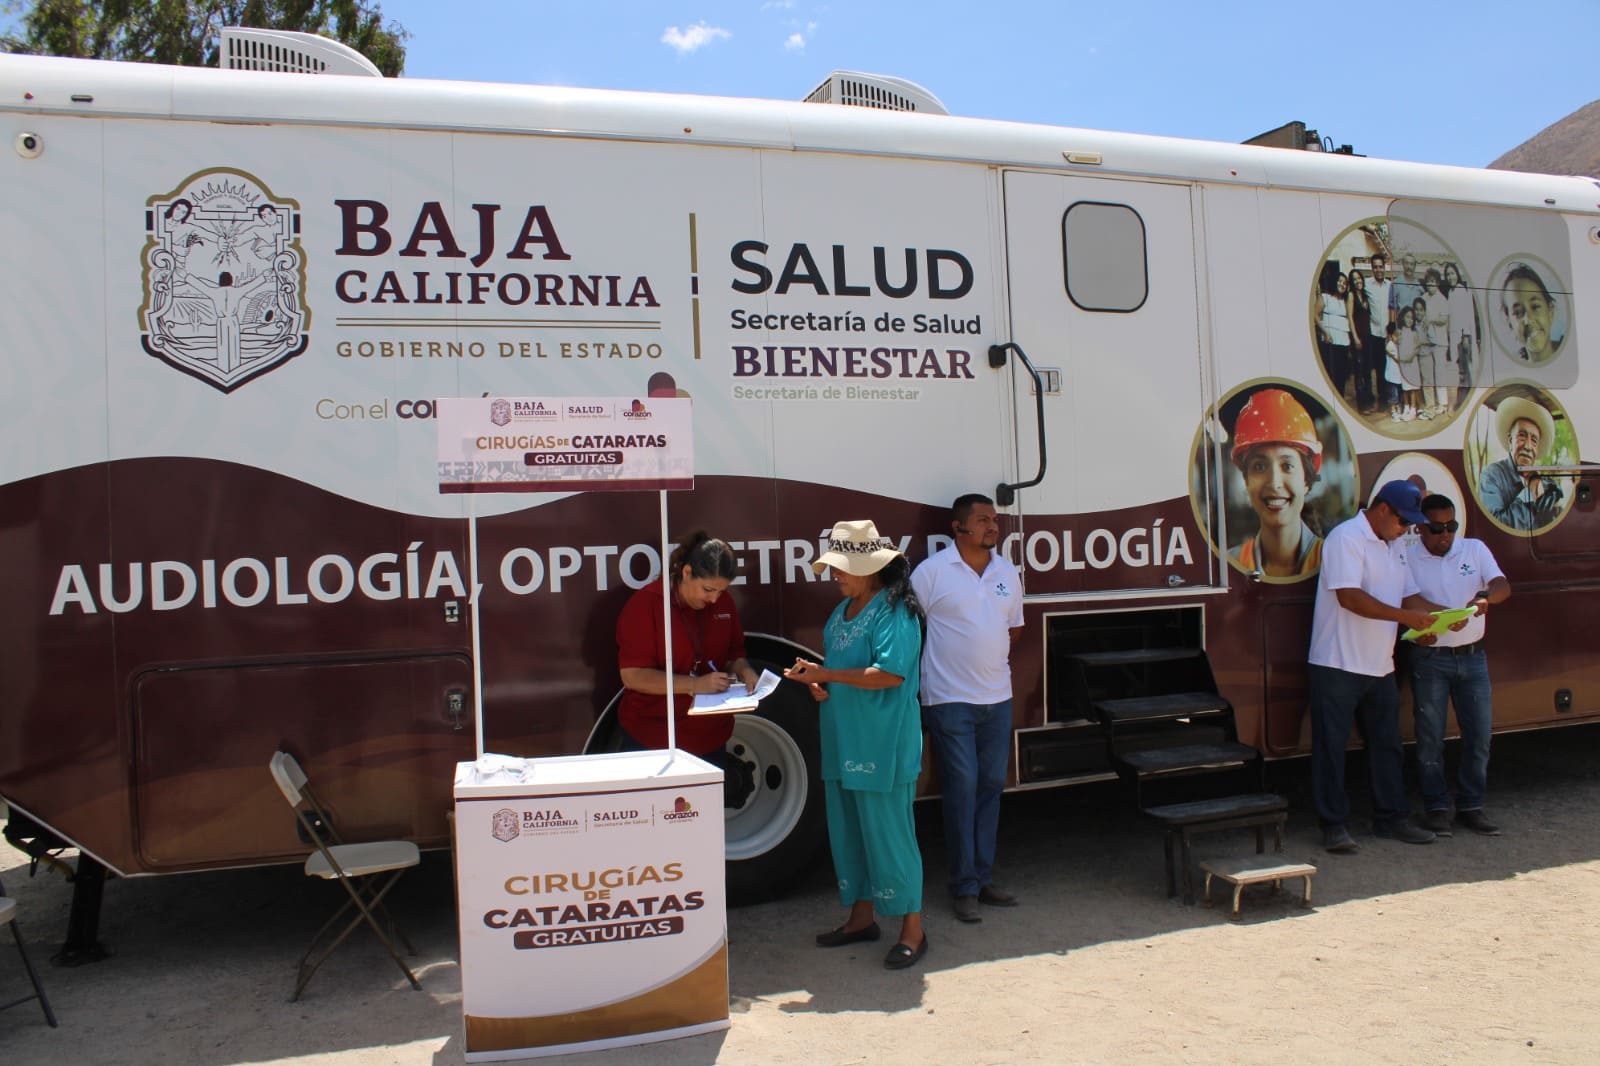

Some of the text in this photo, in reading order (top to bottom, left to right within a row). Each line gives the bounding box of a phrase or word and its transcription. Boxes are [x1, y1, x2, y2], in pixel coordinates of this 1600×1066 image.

[334, 200, 571, 268] BAJA
[730, 240, 974, 300] SALUD
[335, 269, 661, 308] CALIFORNIA
[730, 309, 982, 335] Secretaría de Salud
[336, 341, 664, 359] GOBIERNO DEL ESTADO
[731, 345, 976, 380] BIENESTAR
[733, 384, 920, 401] Secretaría de Bienestar
[315, 398, 365, 420] Con
[368, 397, 389, 420] el
[514, 401, 545, 410] BAJA
[568, 406, 604, 414] SALUD
[476, 434, 667, 450] CIRUGÍAS DE CATARATAS
[534, 453, 617, 465] GRATUITAS
[500, 528, 835, 595] OPTOETRÍ
[927, 518, 1194, 573] PCOLOGÍA
[522, 819, 579, 829] CALIFORNIA
[523, 809, 564, 821] BAJA
[593, 810, 639, 822] SALUD
[503, 862, 685, 896] CIRUGÍAS
[583, 888, 612, 902] DE
[483, 891, 706, 930] CATARATAS
[531, 919, 673, 948] GRATUITAS
